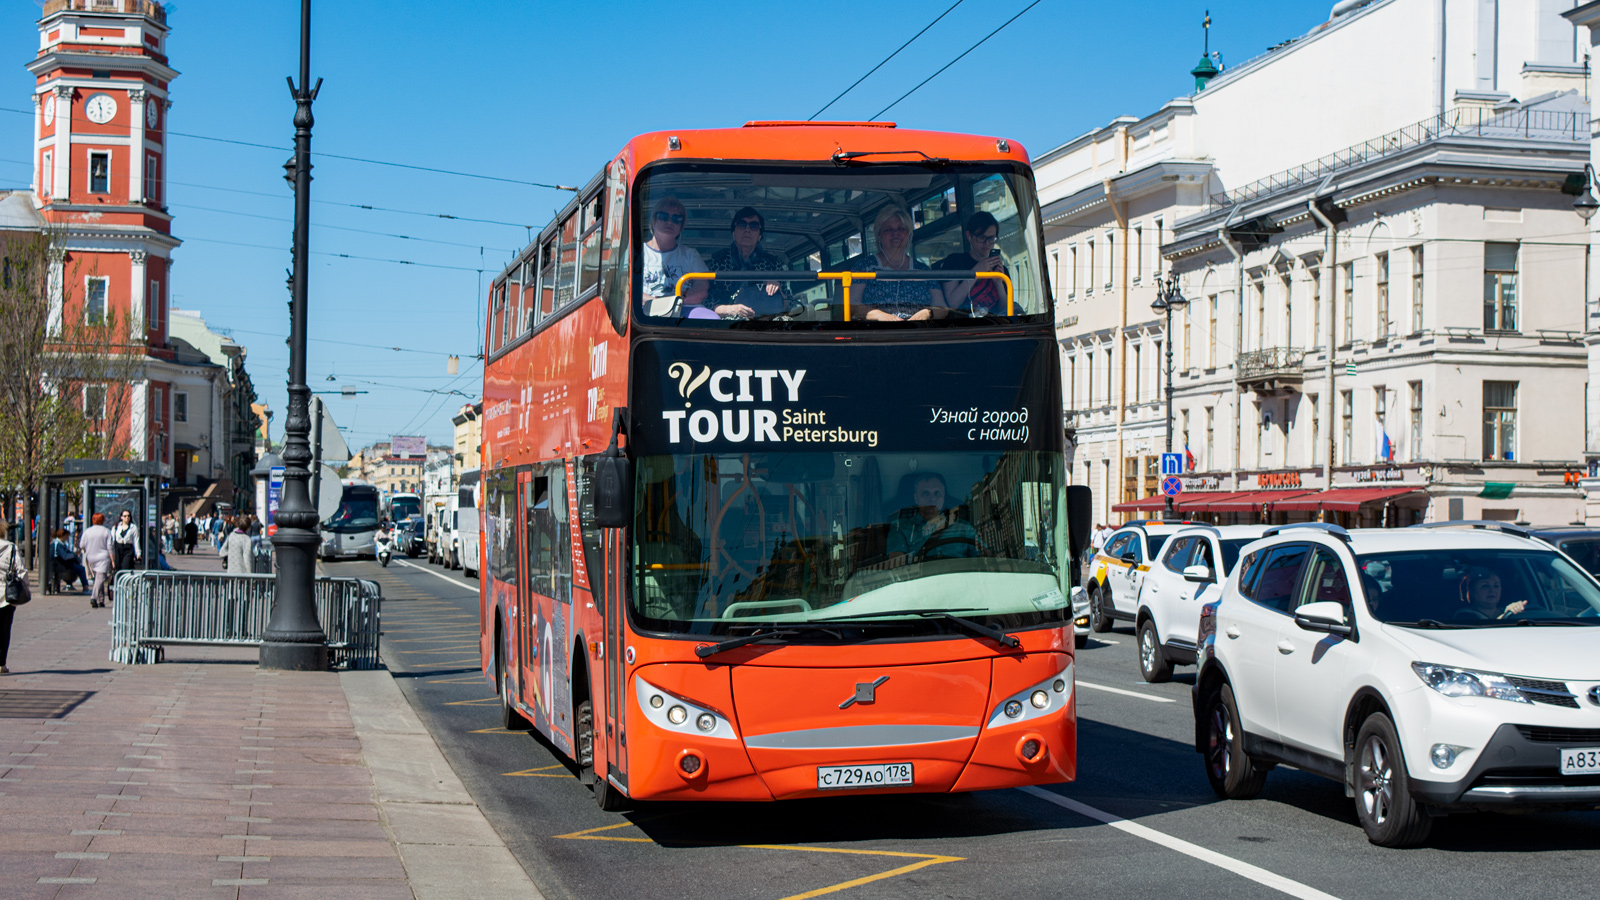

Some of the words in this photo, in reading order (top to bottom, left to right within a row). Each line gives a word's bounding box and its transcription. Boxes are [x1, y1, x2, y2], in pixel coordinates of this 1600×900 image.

[709, 369, 807, 402] CITY
[662, 409, 781, 444] TOUR
[782, 409, 826, 425] Saint
[930, 407, 978, 423] Узнай
[982, 407, 1028, 427] город
[783, 427, 878, 447] Petersburg
[967, 428, 976, 441] с
[980, 425, 1029, 443] нами!)
[1566, 751, 1600, 769] А83
[885, 765, 907, 778] 178
